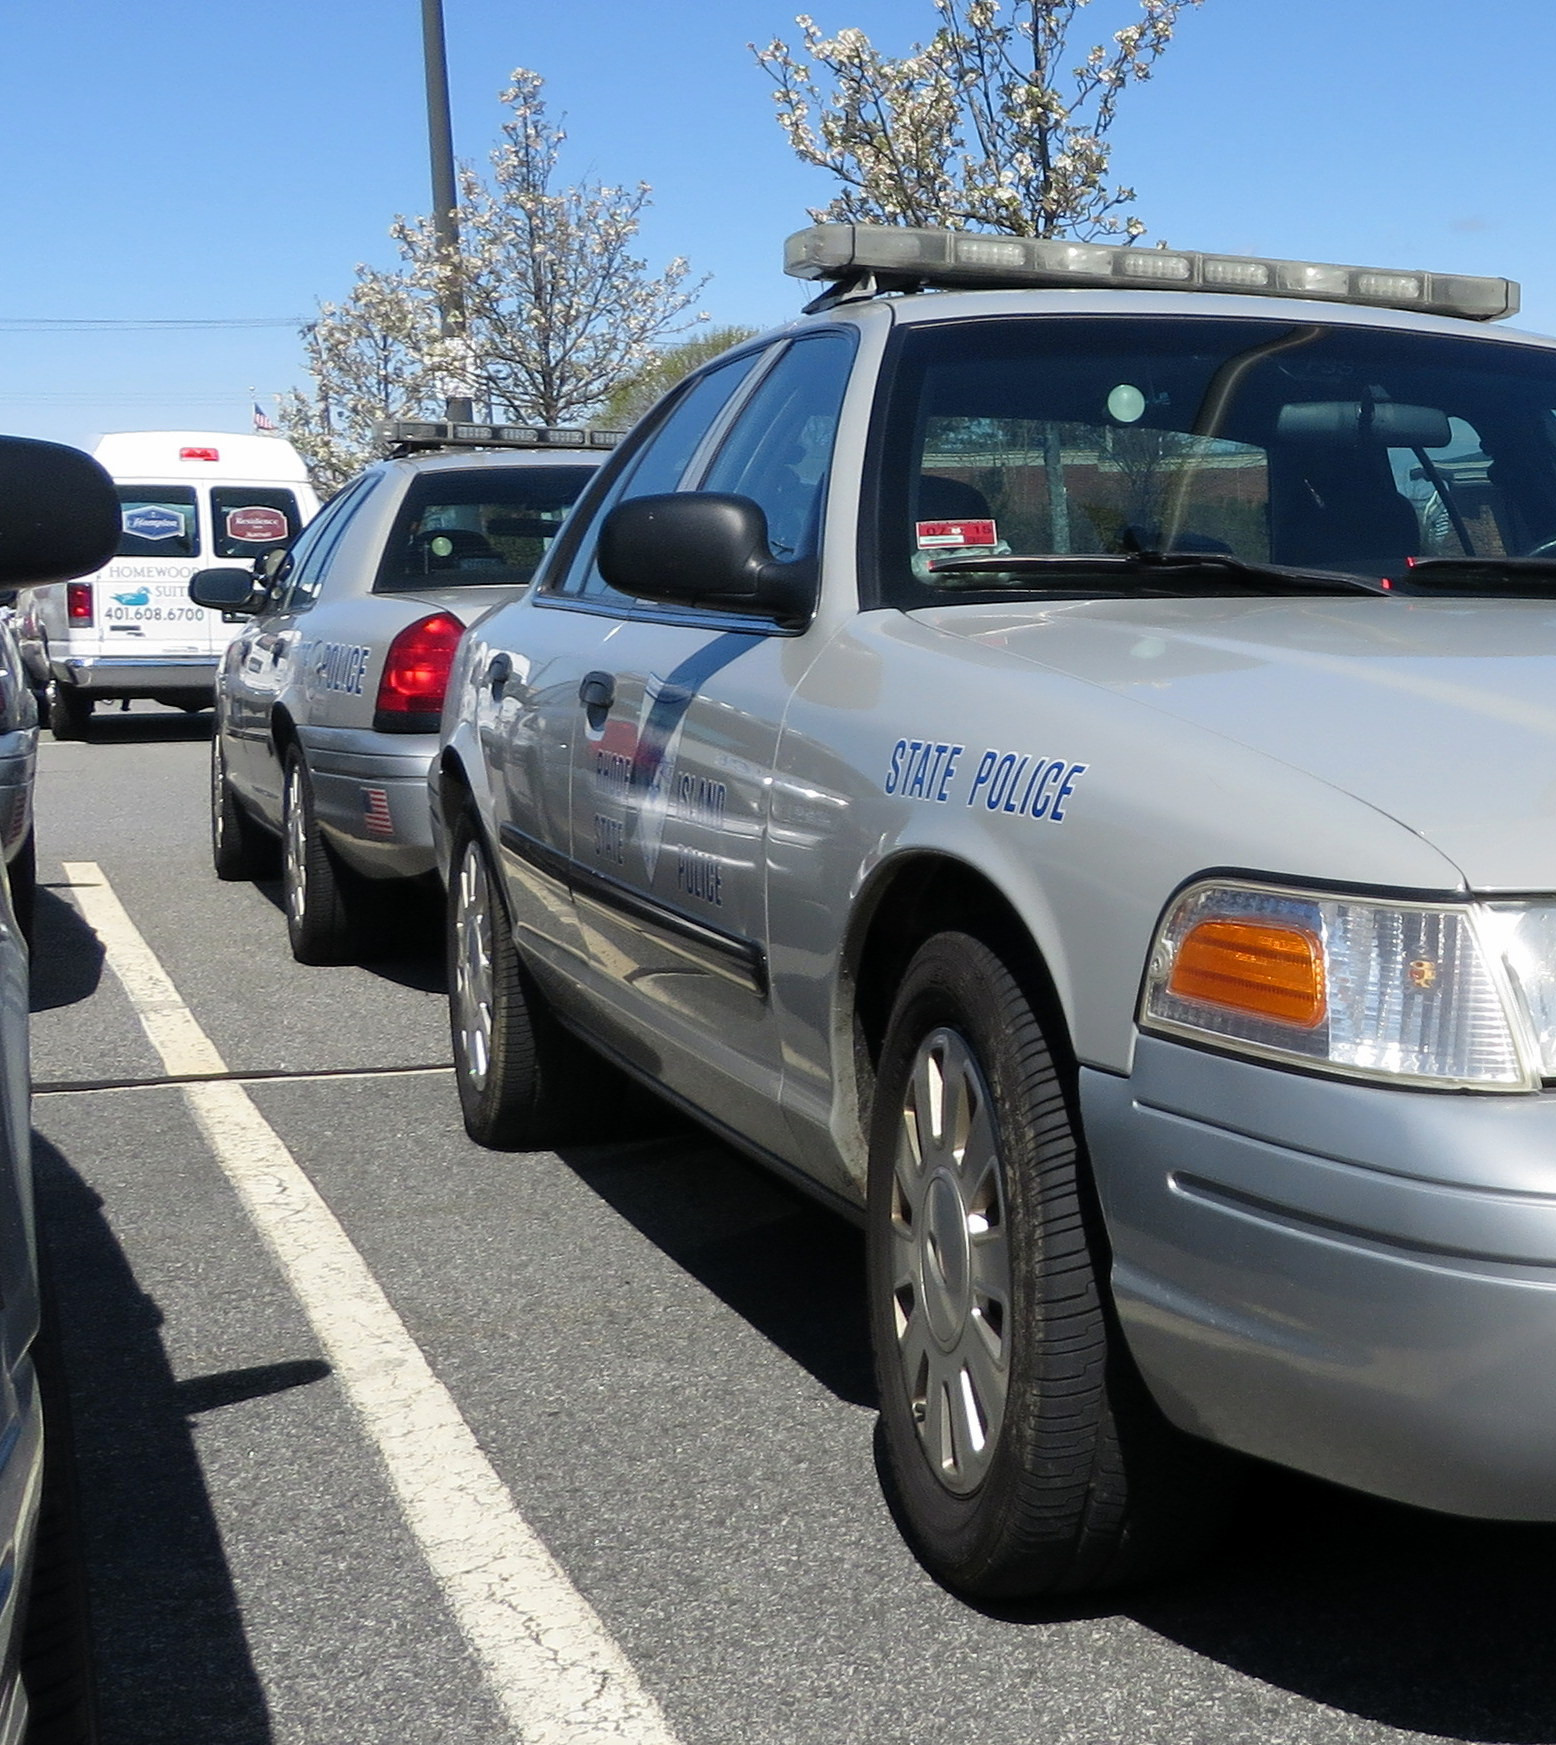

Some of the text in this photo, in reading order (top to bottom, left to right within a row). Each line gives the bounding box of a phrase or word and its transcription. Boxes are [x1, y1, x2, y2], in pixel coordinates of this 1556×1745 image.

[105, 607, 204, 621] 401.608.6700
[155, 586, 187, 597] SUIT
[678, 772, 727, 831] ISLAND
[885, 738, 1090, 824] STATE POLICE
[678, 843, 722, 908] POLICE
